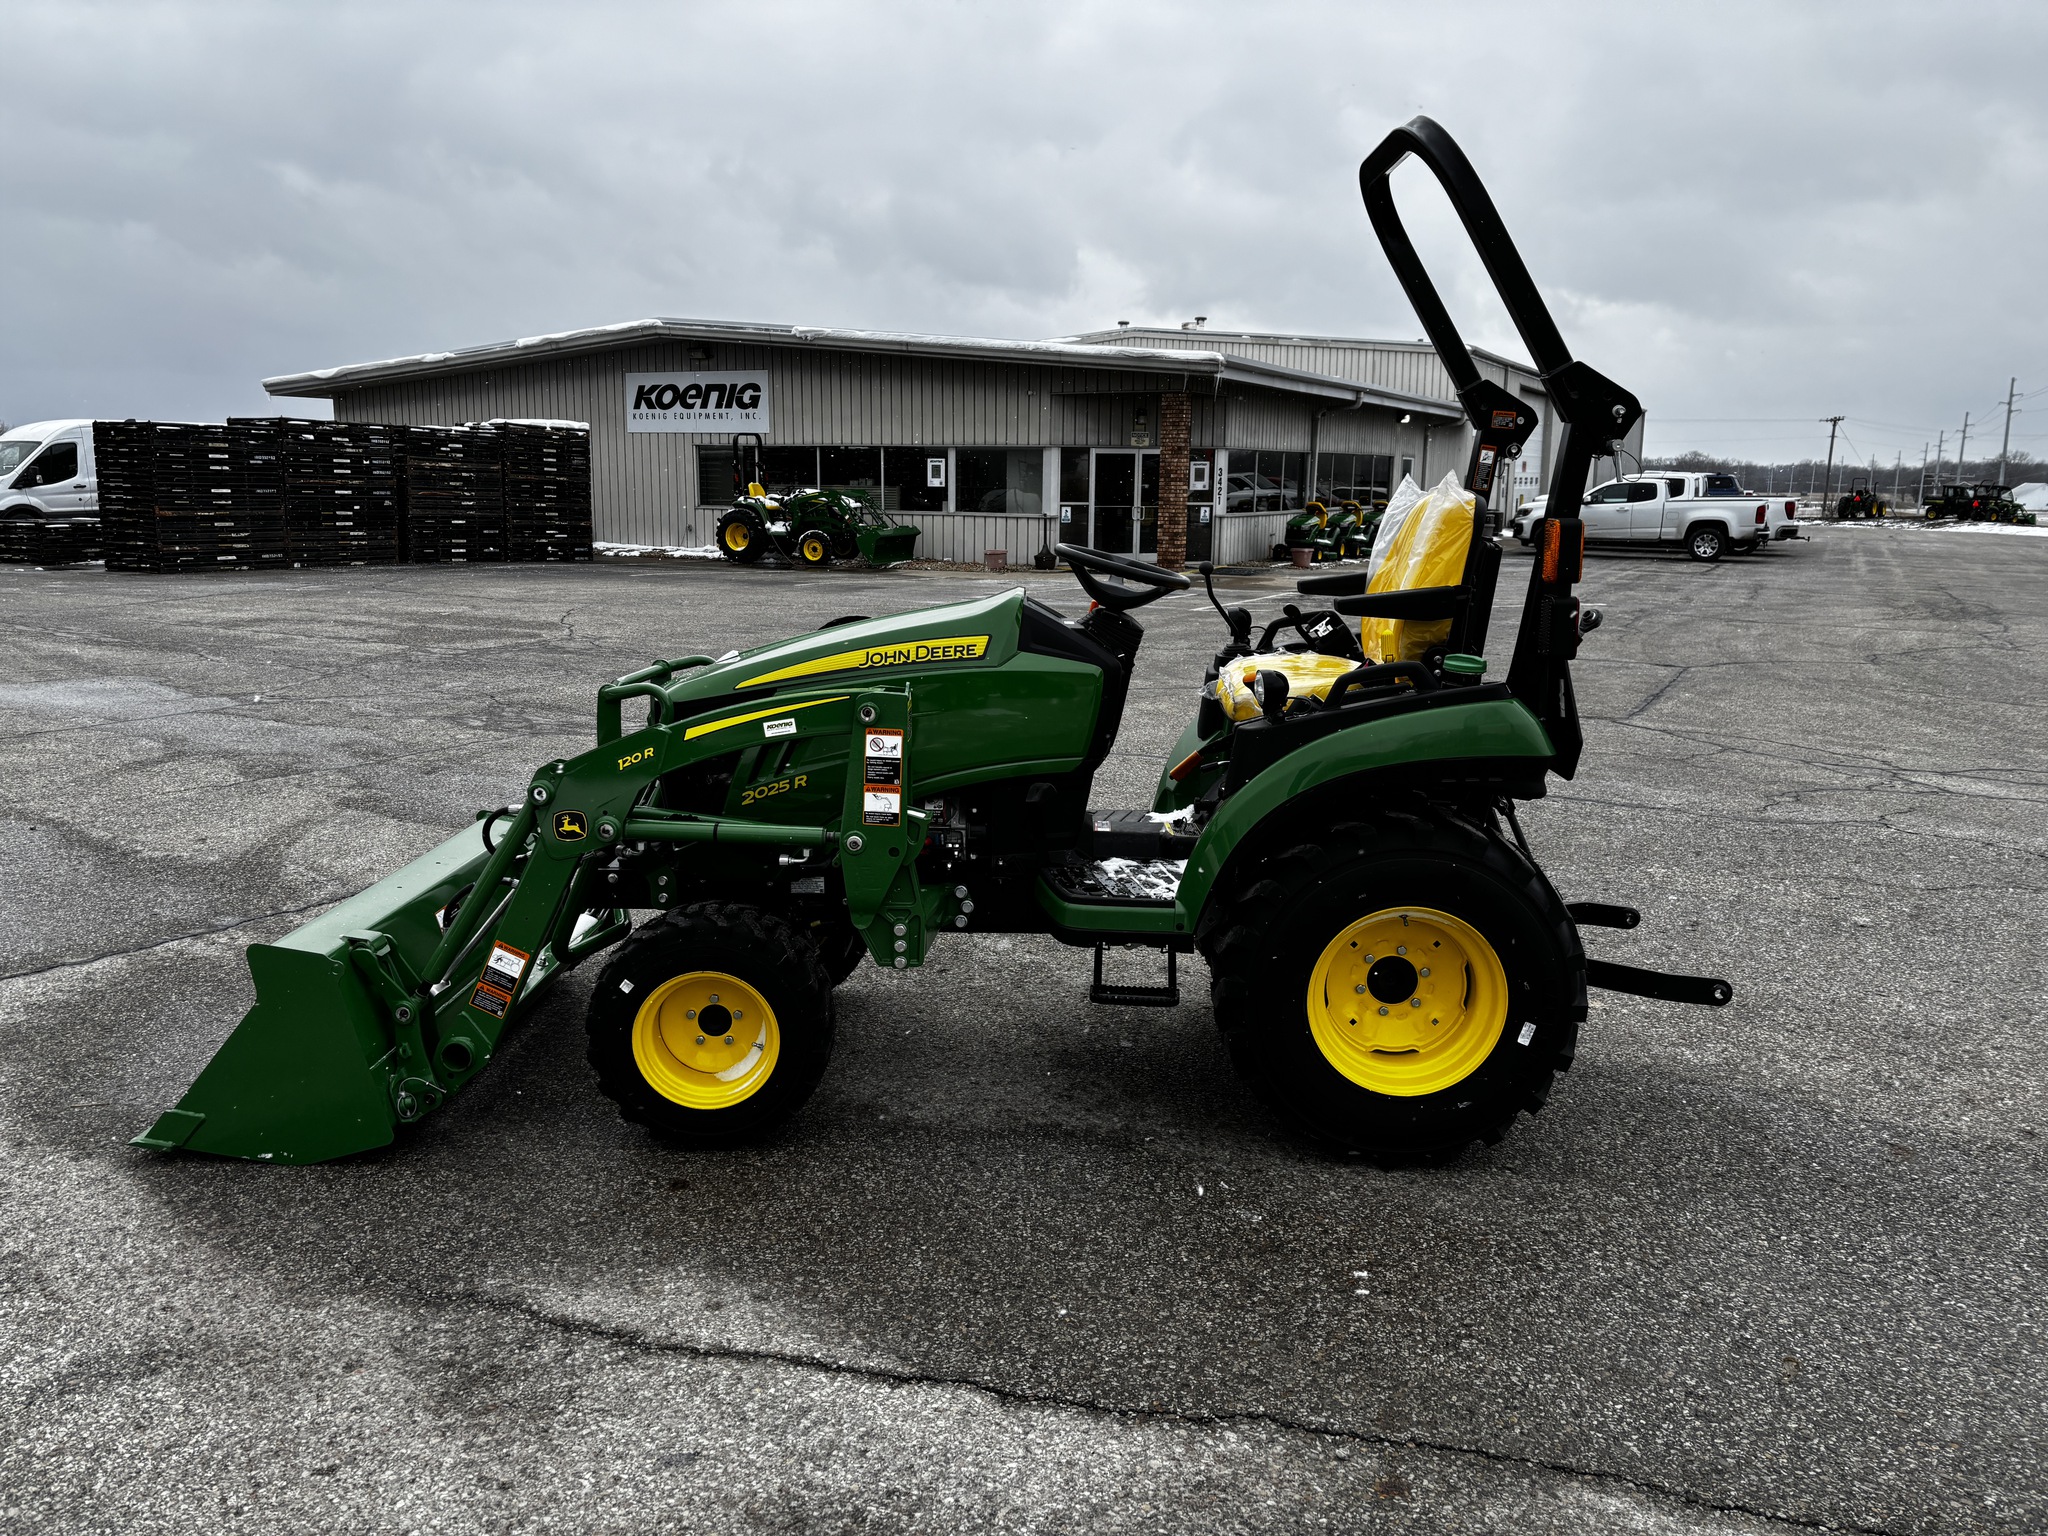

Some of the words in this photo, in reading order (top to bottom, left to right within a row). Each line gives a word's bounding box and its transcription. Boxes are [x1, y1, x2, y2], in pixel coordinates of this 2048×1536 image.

[632, 412, 668, 420] KOENIG
[673, 412, 734, 421] EQUIPMENT,
[740, 412, 762, 420] INC.
[858, 649, 911, 668] JOHN
[915, 644, 978, 660] DEERE
[618, 752, 643, 771] 120
[644, 747, 655, 759] R
[741, 779, 790, 806] 2025
[794, 775, 808, 789] R
[503, 945, 526, 958] WARNING
[486, 987, 508, 1000] WARNING
